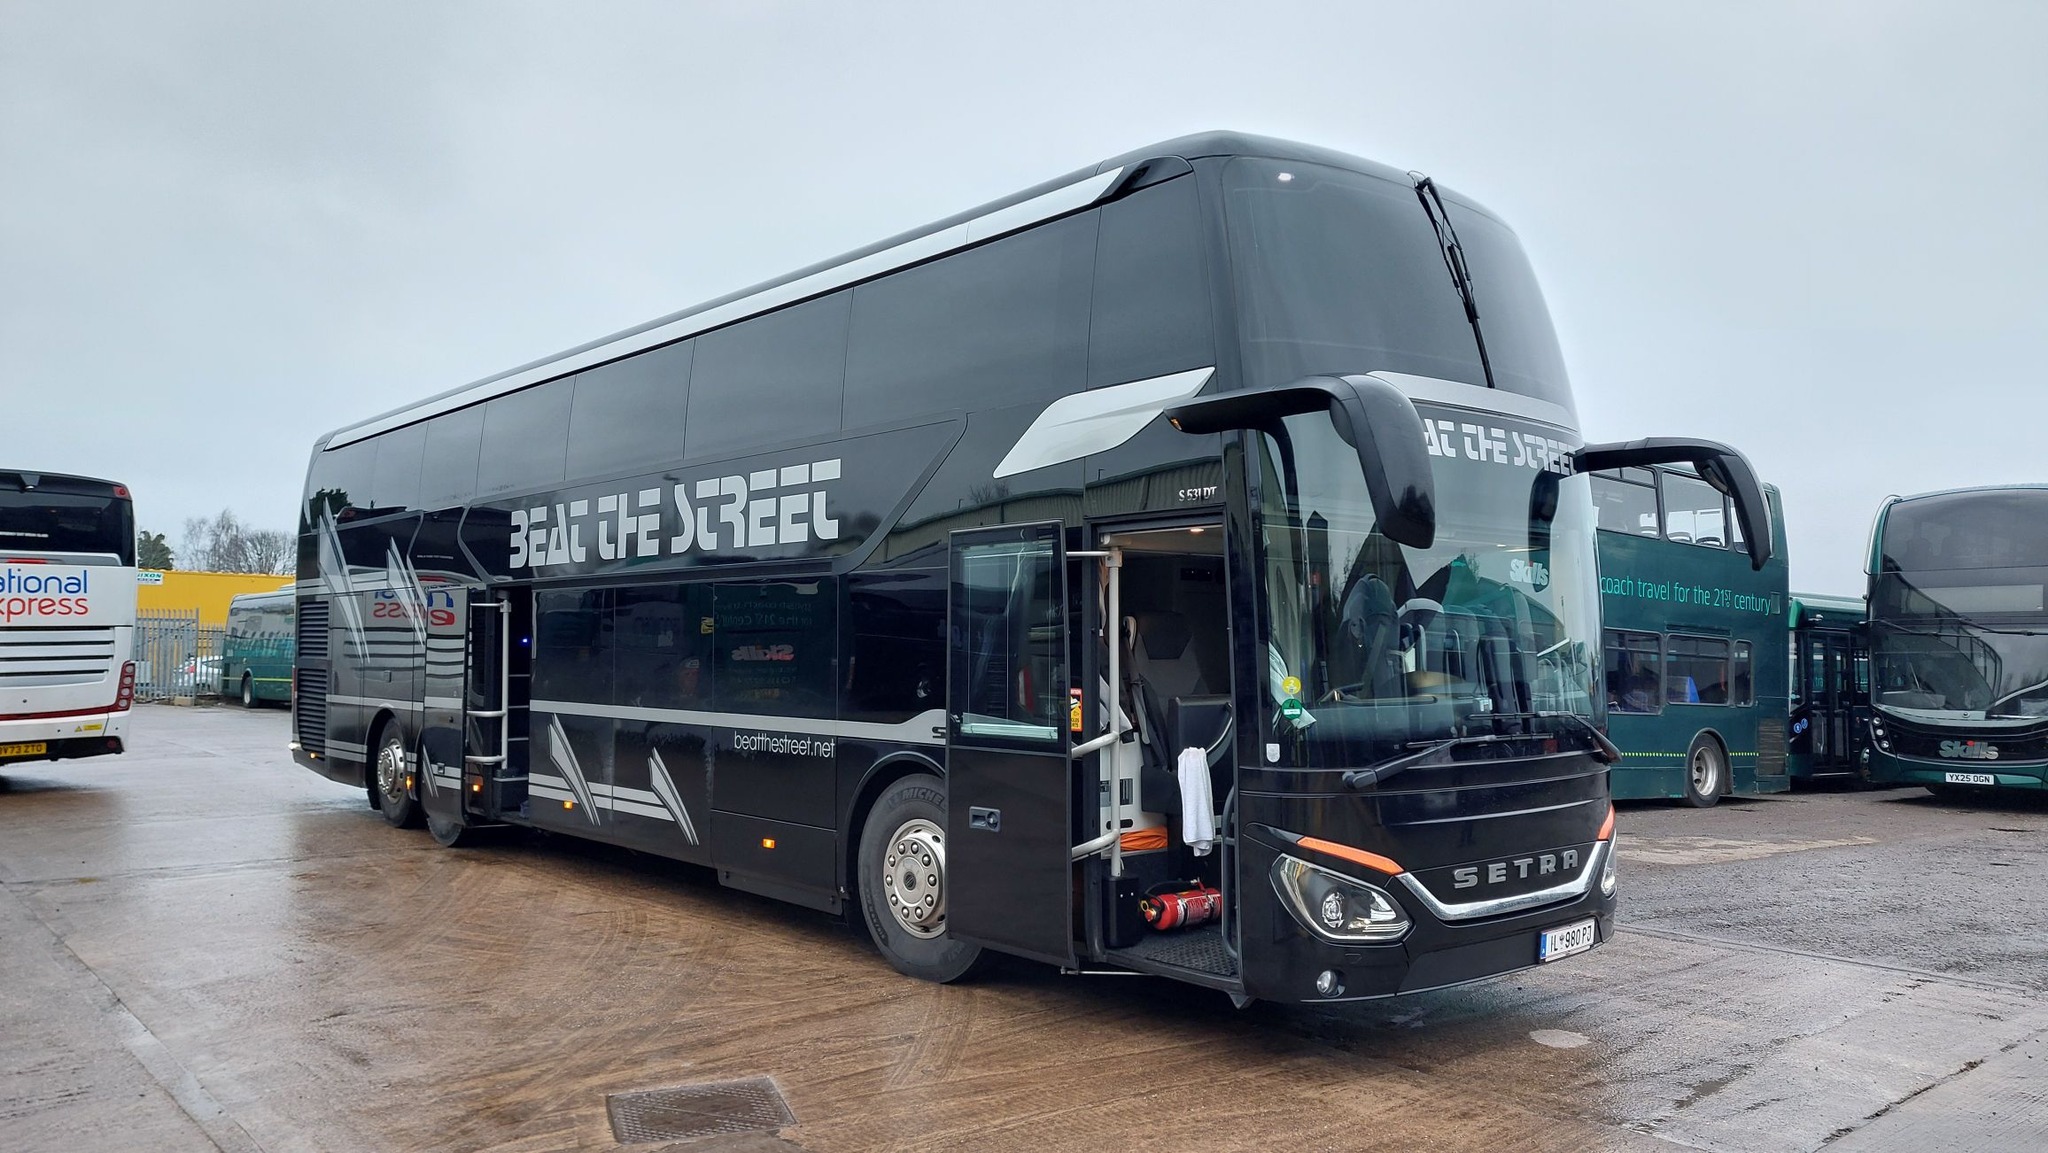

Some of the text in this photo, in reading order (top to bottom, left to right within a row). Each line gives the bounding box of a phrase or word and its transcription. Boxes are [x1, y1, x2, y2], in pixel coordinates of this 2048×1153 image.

[1423, 418, 1457, 458] AT
[1461, 423, 1508, 465] THE
[509, 458, 842, 569] BEAT THE STREET
[0, 568, 88, 594] tional
[1509, 558, 1549, 586] Skills
[1600, 576, 1634, 596] coach
[1637, 578, 1670, 600] travel
[1673, 582, 1691, 603] for
[1693, 585, 1711, 605] the
[1734, 593, 1772, 616] century
[0, 598, 89, 623] press
[734, 730, 836, 758] beatthestreet.net
[1938, 740, 1999, 760] Skills
[1949, 773, 1990, 783] YX25 OGN
[901, 787, 945, 807] MICHE
[1452, 849, 1579, 890] SETRA
[1565, 929, 1581, 949] 980
